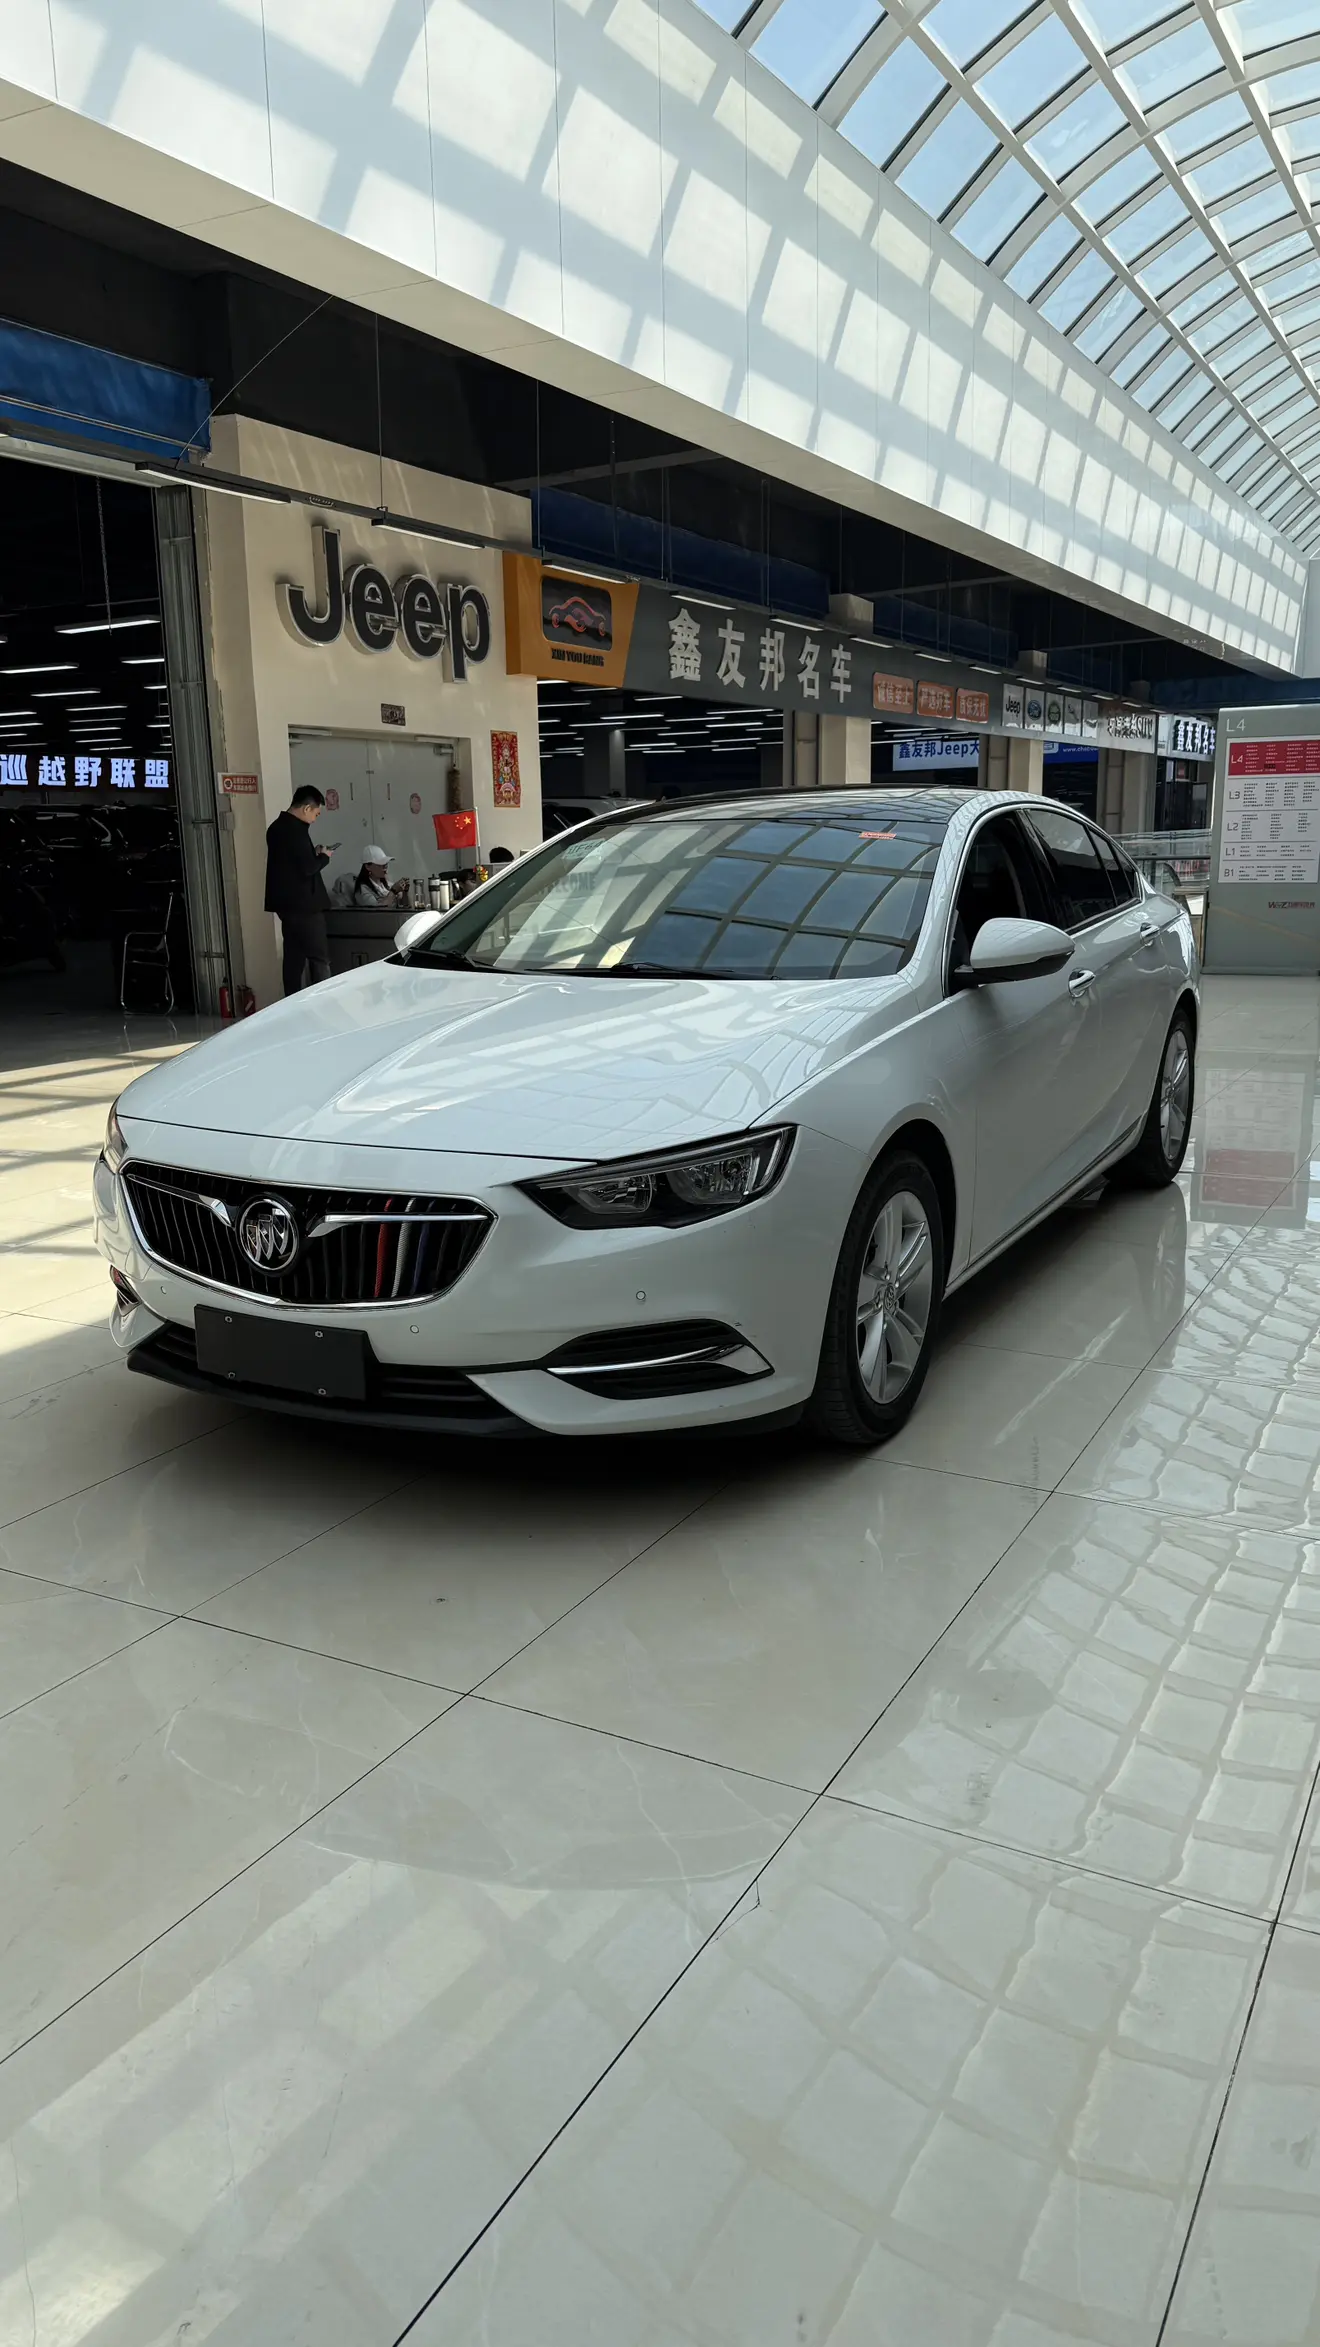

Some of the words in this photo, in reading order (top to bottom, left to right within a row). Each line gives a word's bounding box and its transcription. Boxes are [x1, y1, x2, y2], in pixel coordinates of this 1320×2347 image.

[277, 526, 491, 682] Jeep
[668, 608, 852, 703] 鑫友邦名车
[1005, 695, 1021, 717] Jeep
[1226, 718, 1246, 732] L4
[1177, 719, 1216, 755] 鑫友邦名车
[898, 740, 980, 759] 鑫友邦Jeep大
[1231, 755, 1243, 764] L4
[0, 754, 170, 789] 巡越野联盟
[1229, 791, 1241, 800] L3
[1227, 822, 1239, 832] L2
[1225, 847, 1235, 856] L1
[1224, 868, 1234, 877] B1
